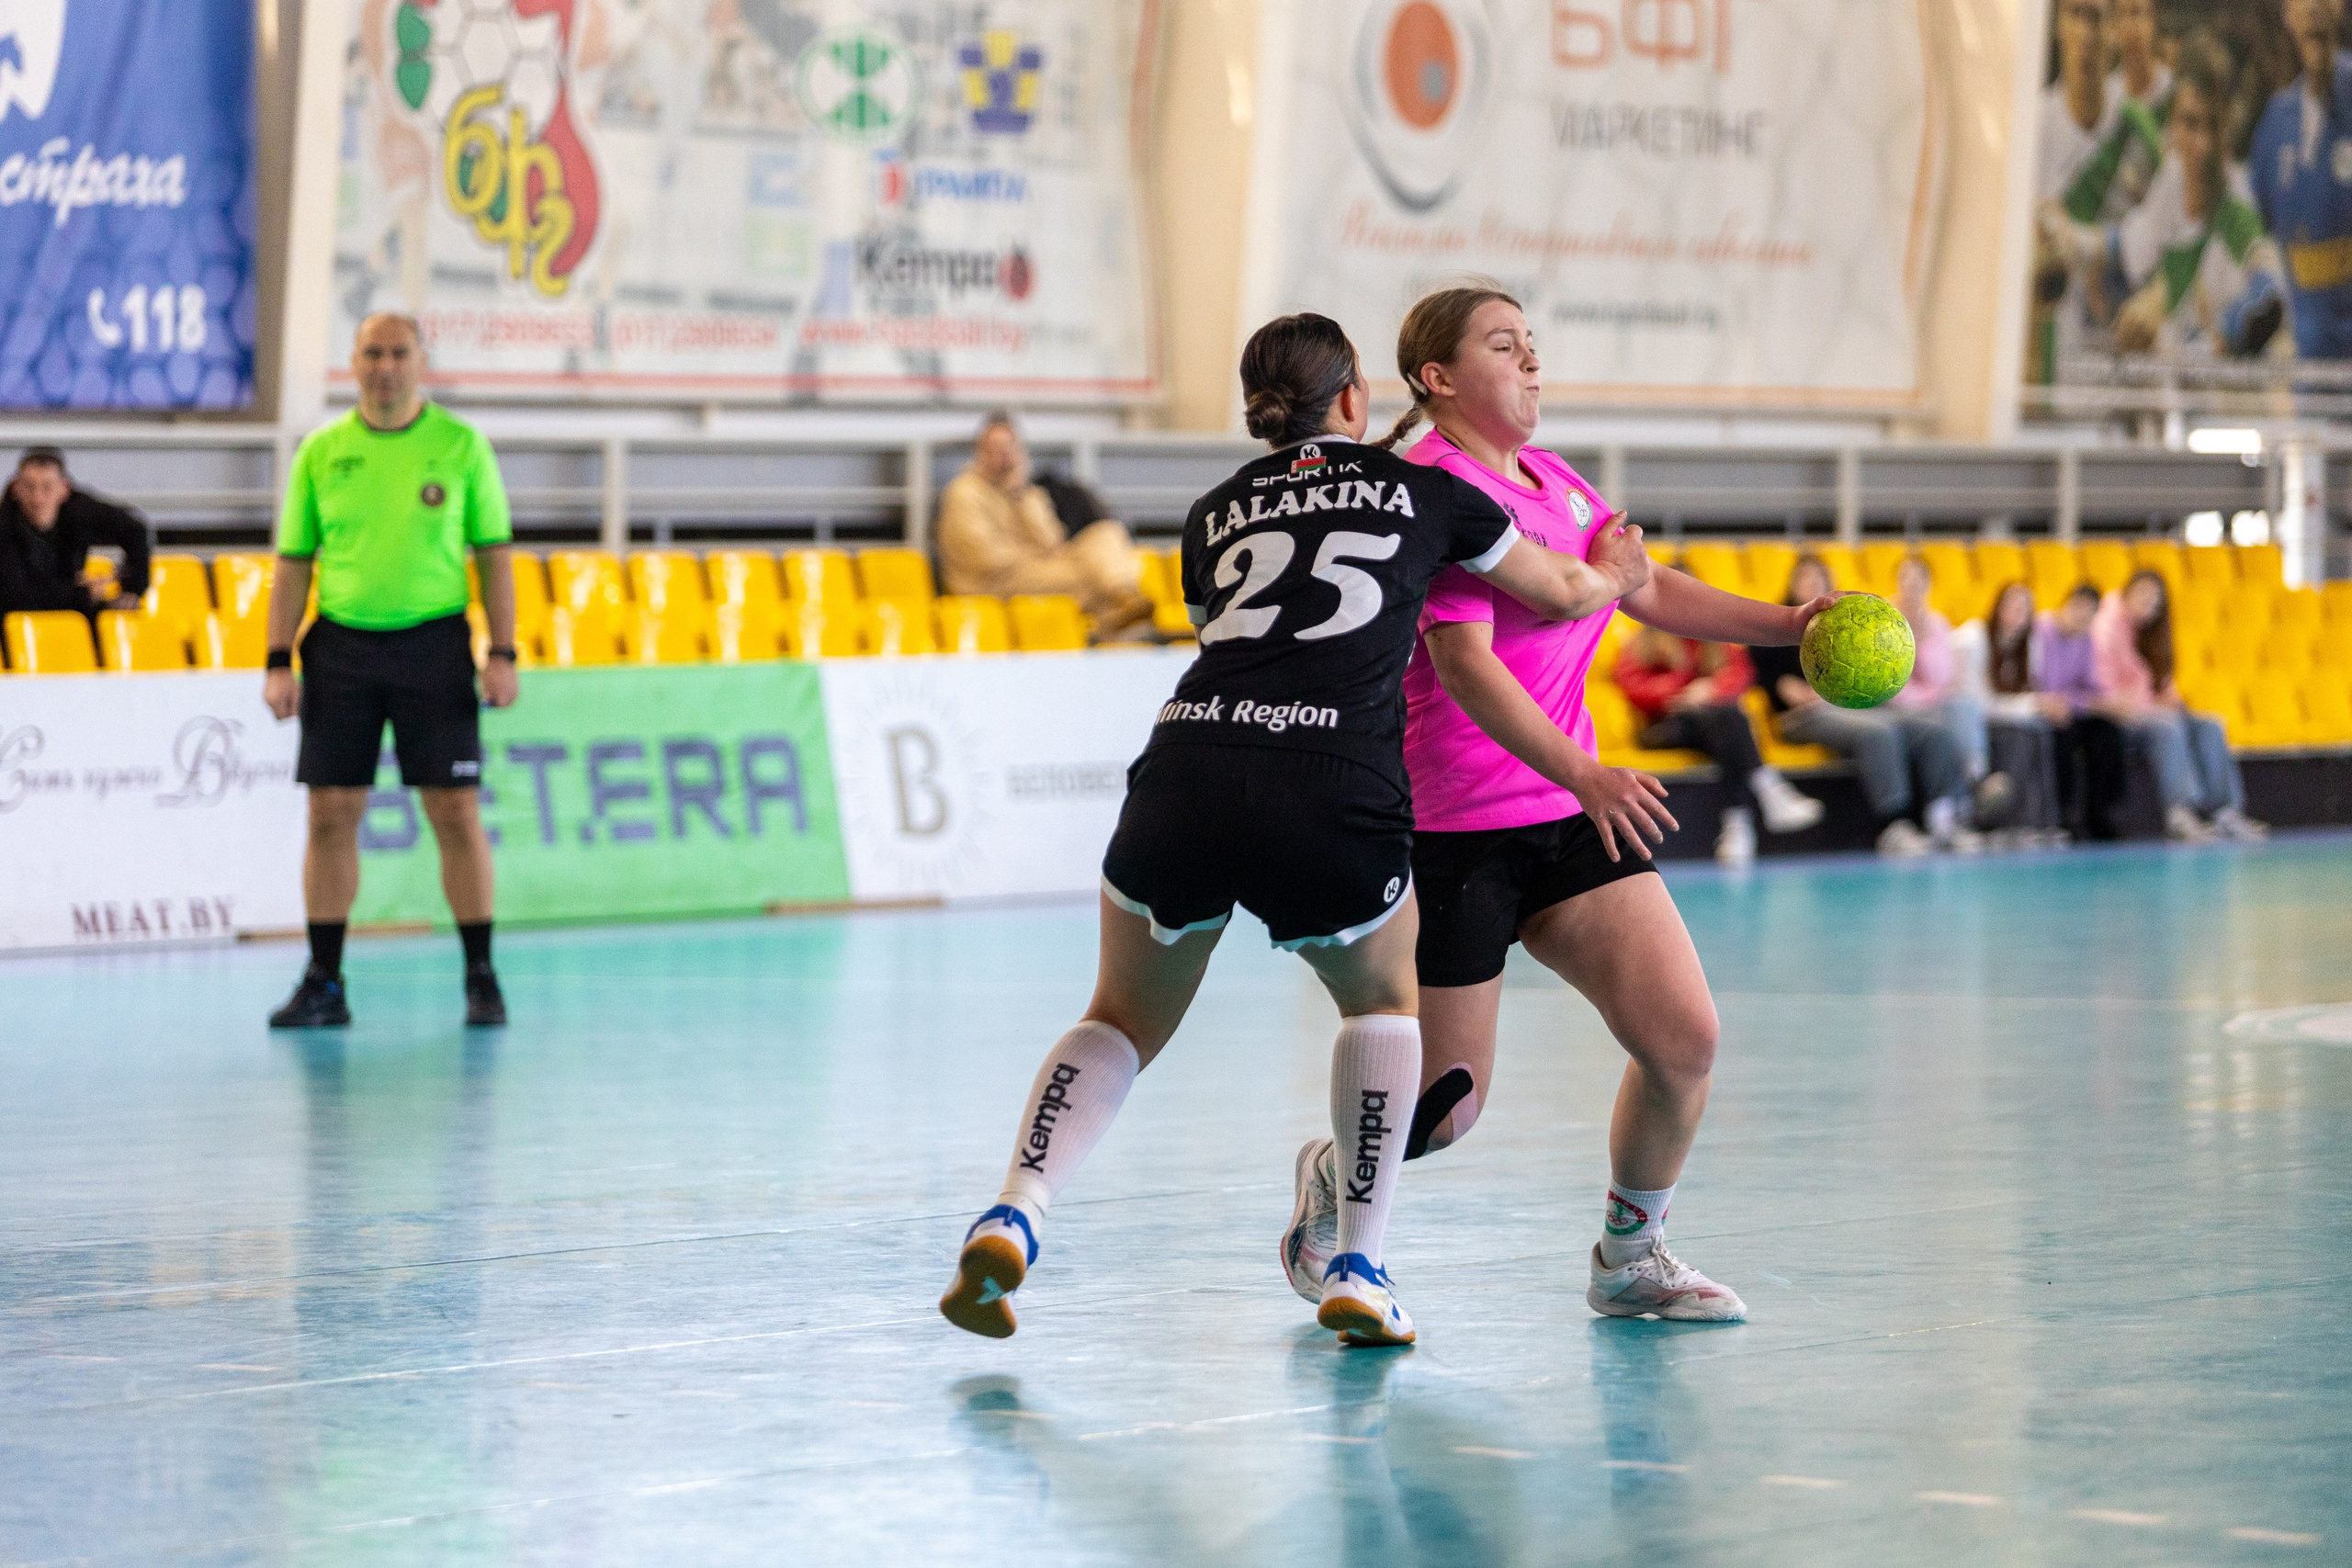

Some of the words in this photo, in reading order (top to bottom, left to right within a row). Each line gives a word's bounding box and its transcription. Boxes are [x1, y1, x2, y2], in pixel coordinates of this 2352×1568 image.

[854, 233, 1000, 299] Kempa
[123, 284, 207, 354] 118
[1204, 479, 1415, 547] LALAKINA
[1200, 530, 1401, 642] 25
[1231, 699, 1339, 732] Region
[357, 731, 808, 850] BT.ERA
[71, 895, 236, 940] MEAT.BY
[1019, 1062, 1080, 1174] Kempa
[1346, 1089, 1393, 1204] Kempa
